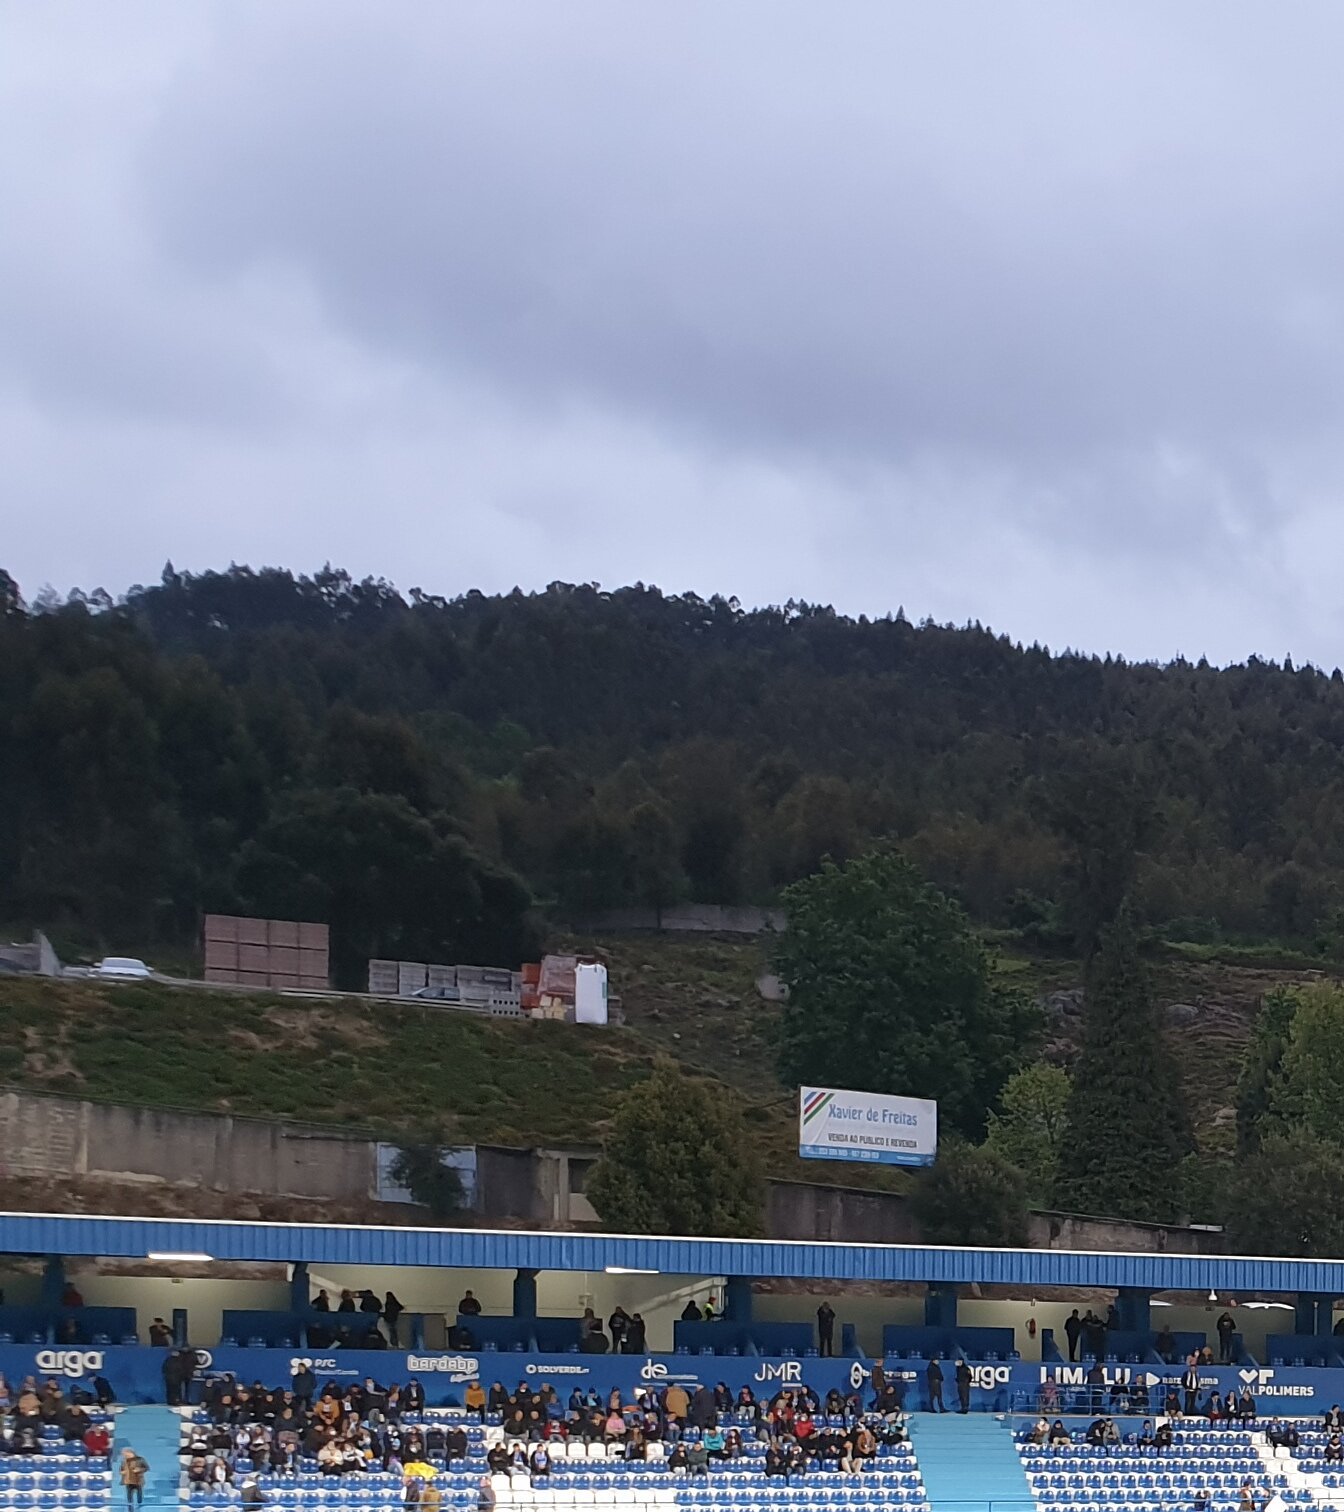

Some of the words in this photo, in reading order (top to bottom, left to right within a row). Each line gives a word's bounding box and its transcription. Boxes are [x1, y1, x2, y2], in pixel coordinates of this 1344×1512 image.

[828, 1104, 862, 1121] Xavier
[866, 1109, 879, 1122] de
[882, 1109, 917, 1126] Freitas
[36, 1350, 104, 1377] arga
[754, 1361, 802, 1381] JMR
[1040, 1366, 1131, 1385] LIMLU
[1239, 1385, 1314, 1396] VALPOLIMERS
